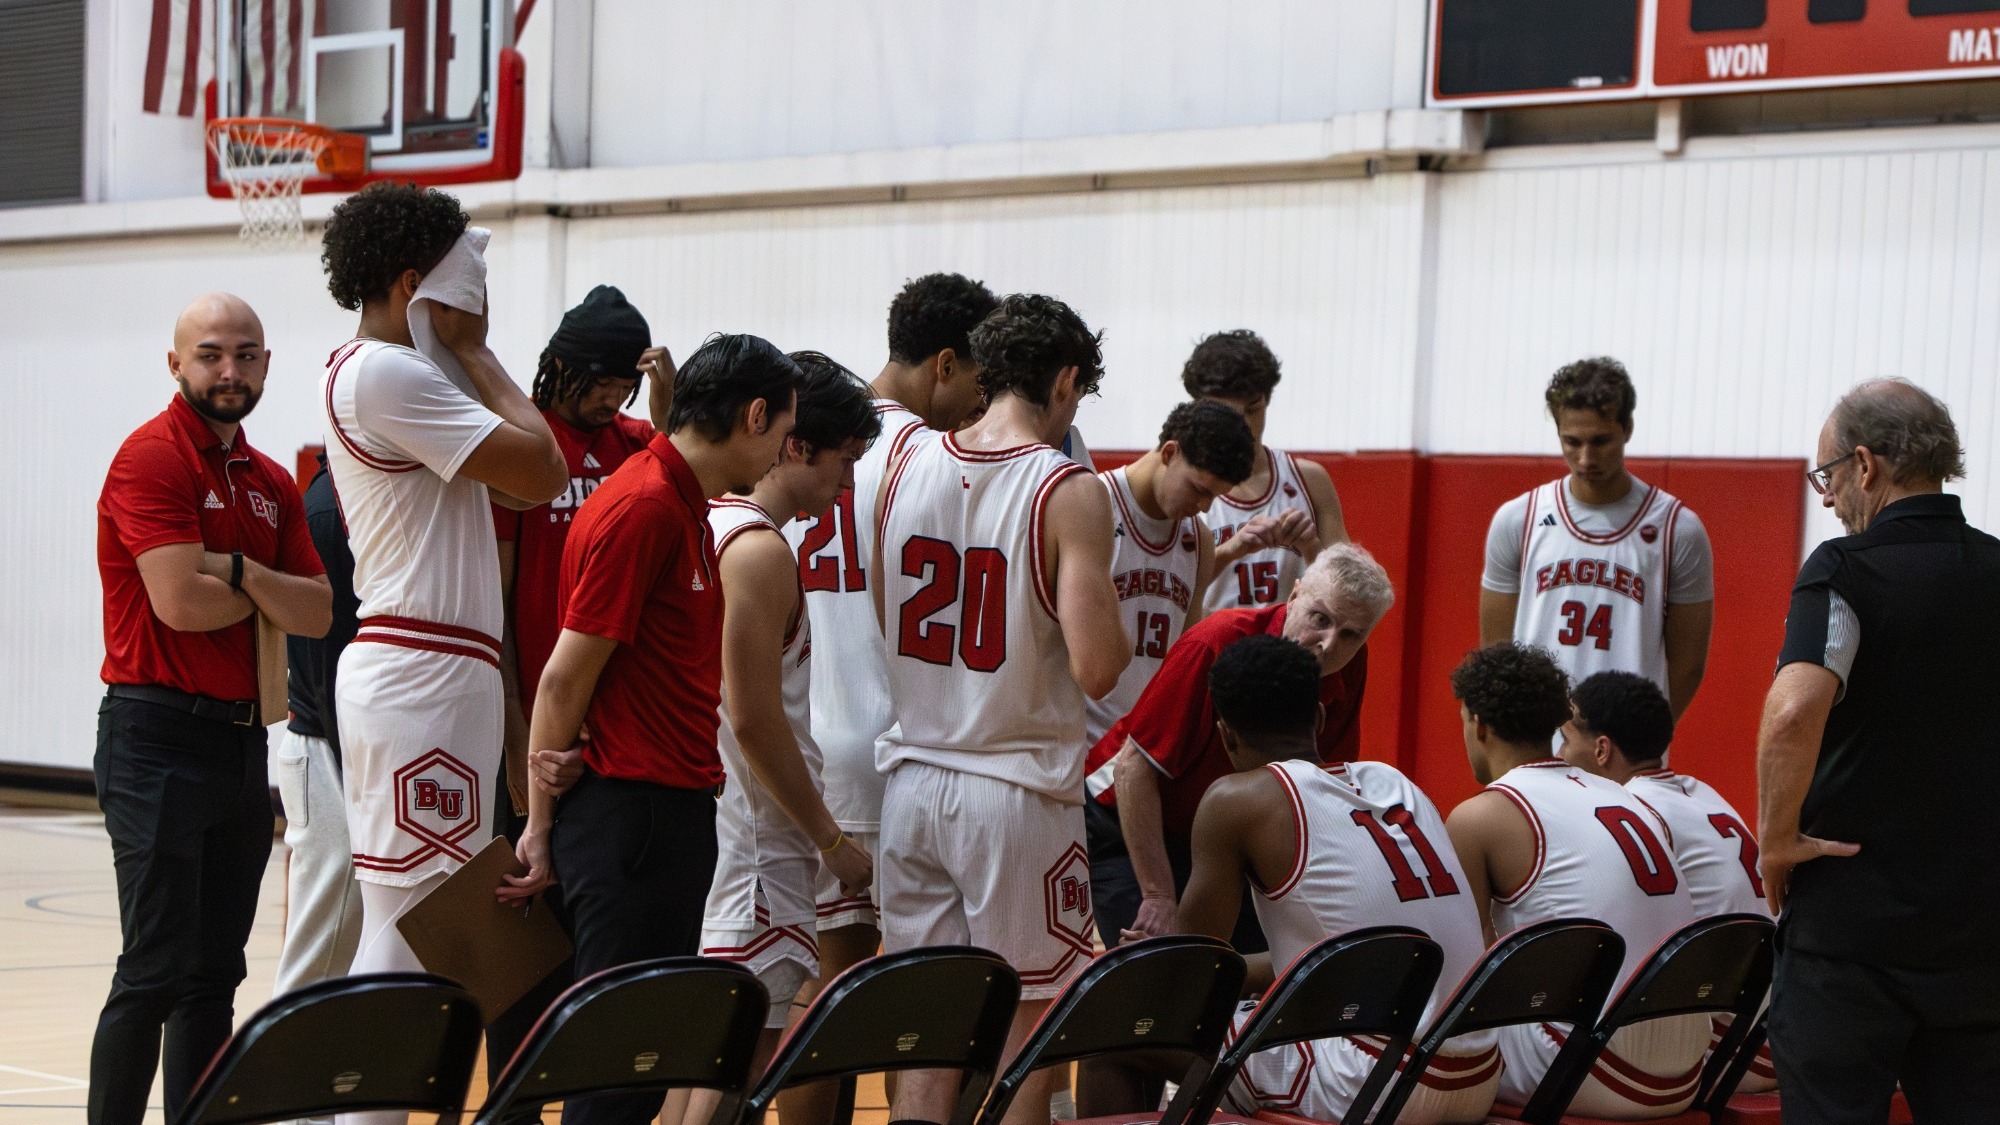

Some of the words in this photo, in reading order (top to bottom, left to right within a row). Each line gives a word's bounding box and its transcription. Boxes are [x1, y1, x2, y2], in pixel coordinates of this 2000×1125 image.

[1706, 43, 1768, 78] WON
[247, 490, 278, 529] BU
[898, 534, 1008, 673] 20
[1234, 561, 1279, 605] 15
[1536, 557, 1646, 606] EAGLES
[1134, 611, 1171, 659] 13
[1558, 600, 1613, 651] 34
[414, 779, 463, 820] BU
[1349, 802, 1461, 903] 11
[1594, 805, 1679, 896] 0
[1061, 876, 1090, 917] BU
